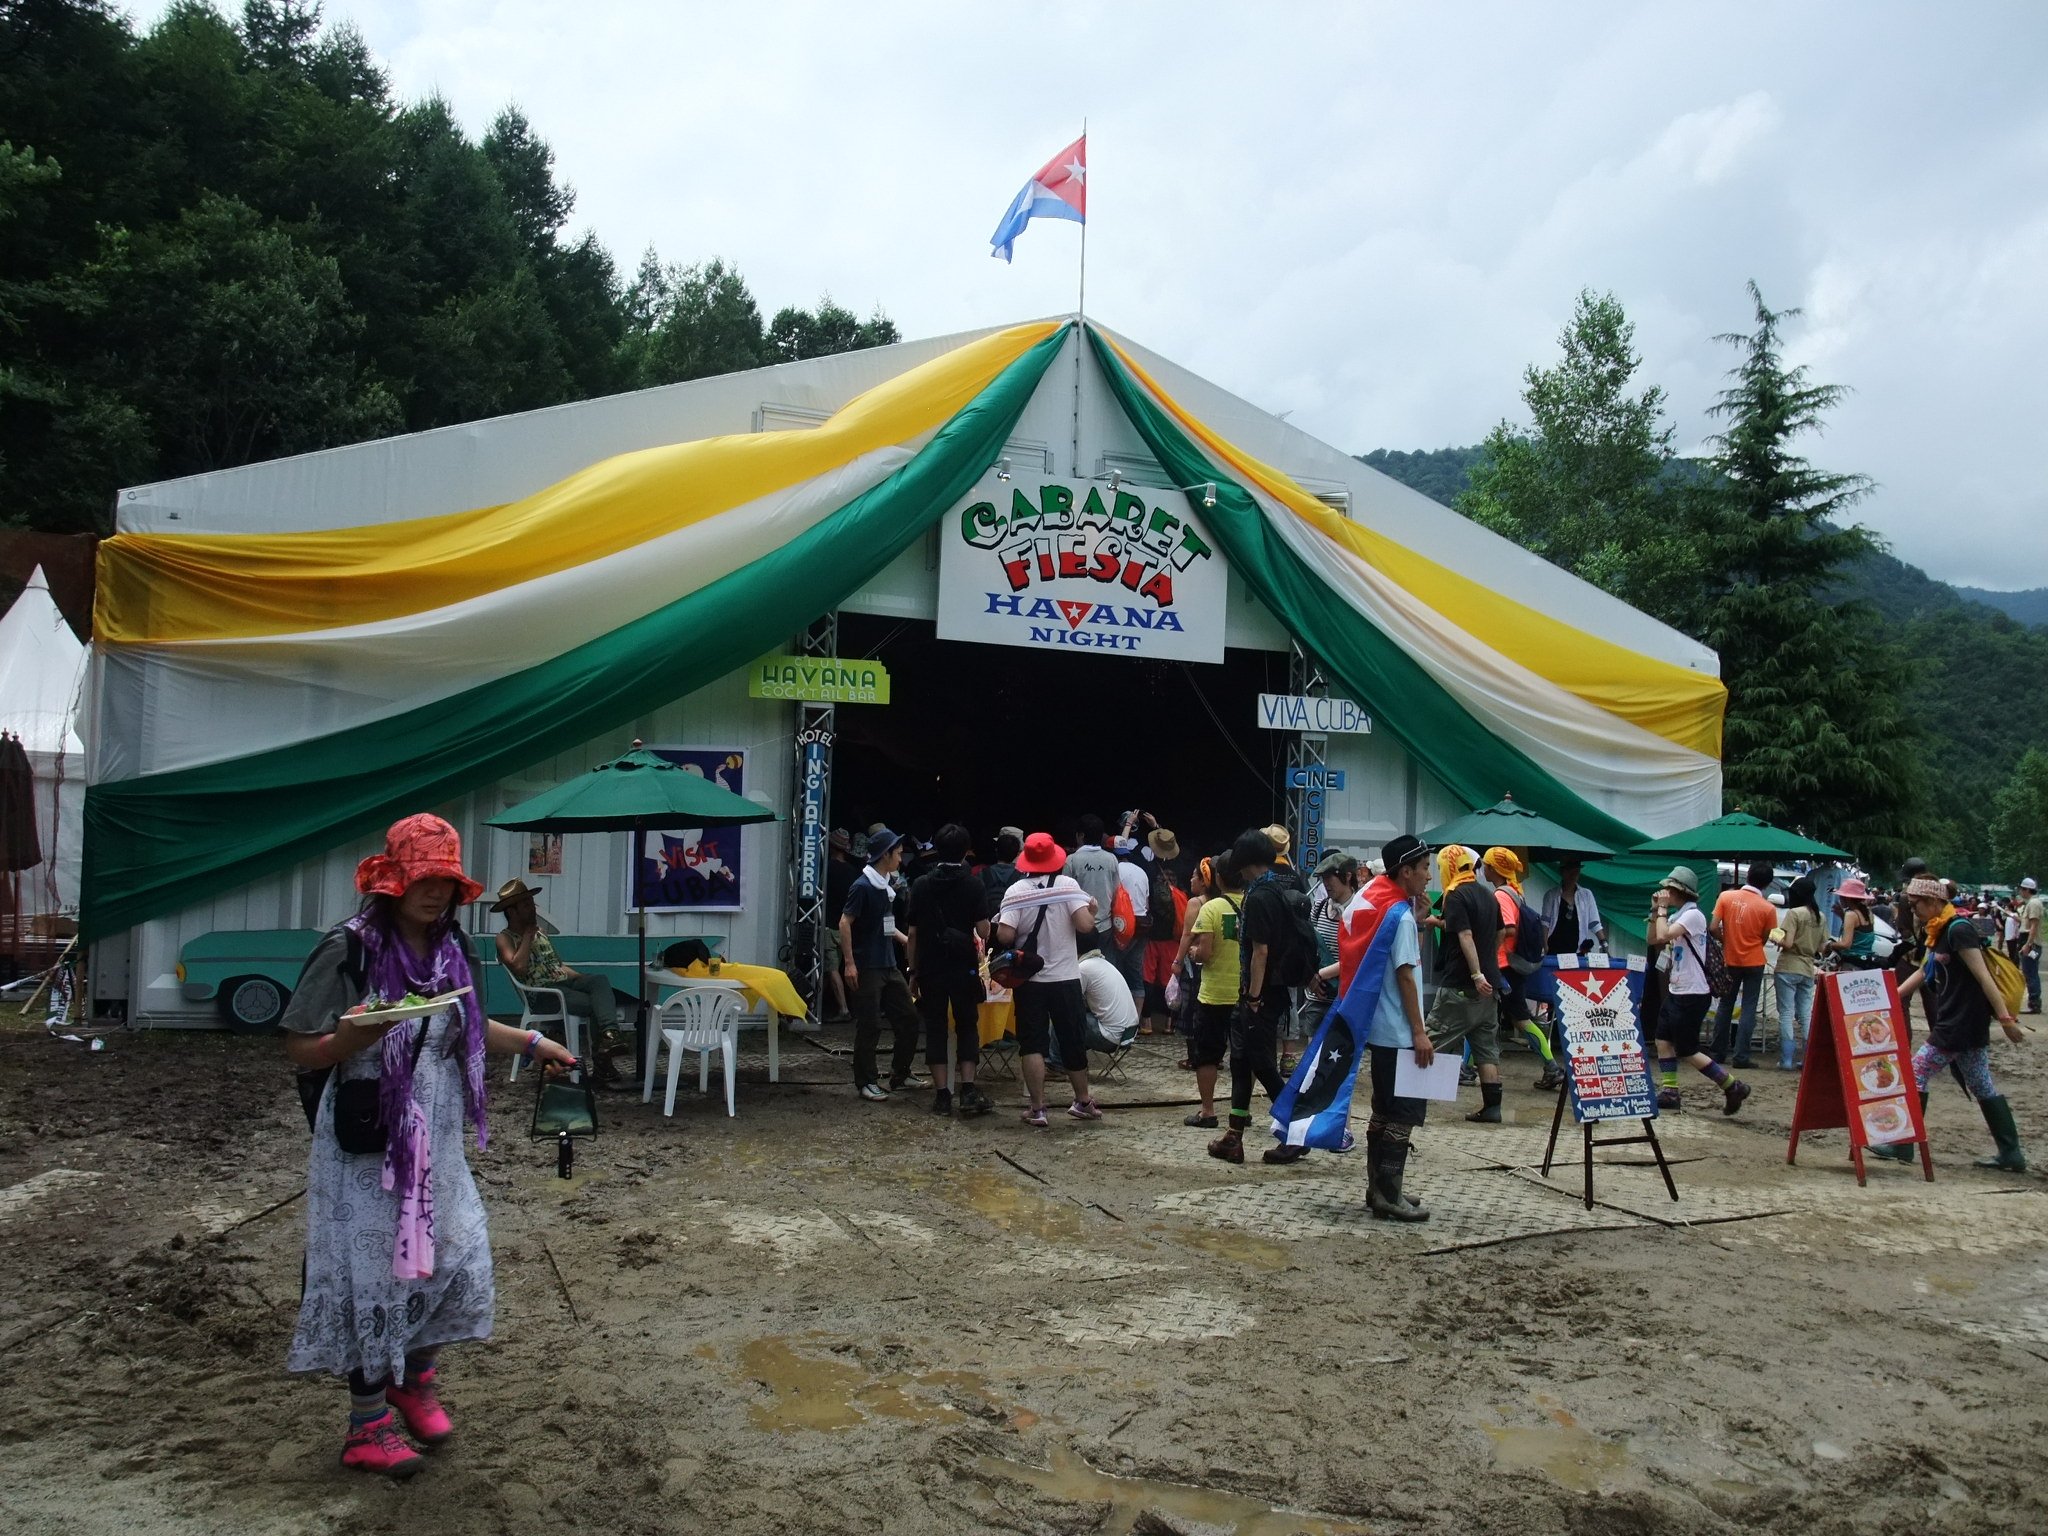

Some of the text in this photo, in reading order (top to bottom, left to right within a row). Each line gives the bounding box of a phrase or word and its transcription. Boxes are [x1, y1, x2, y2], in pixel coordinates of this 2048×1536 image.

[962, 485, 1211, 572] CABARET
[998, 534, 1174, 607] FIESTA
[1029, 627, 1141, 650] NIGHT
[794, 658, 843, 669] CLUB
[761, 665, 876, 690] HAVANA
[761, 685, 876, 702] COCKTAIL BAR
[1316, 698, 1371, 732] CUBA
[797, 729, 832, 747] HOTEL
[1293, 770, 1338, 790] CINE
[802, 743, 821, 897] INGLATERRA
[1306, 790, 1321, 869] CUBA
[659, 840, 719, 870] VISIT
[641, 869, 733, 904] CUBA
[1585, 1008, 1618, 1019] CABARET
[1590, 1018, 1615, 1028] FIESTA
[1610, 1029, 1636, 1042] NIGHT
